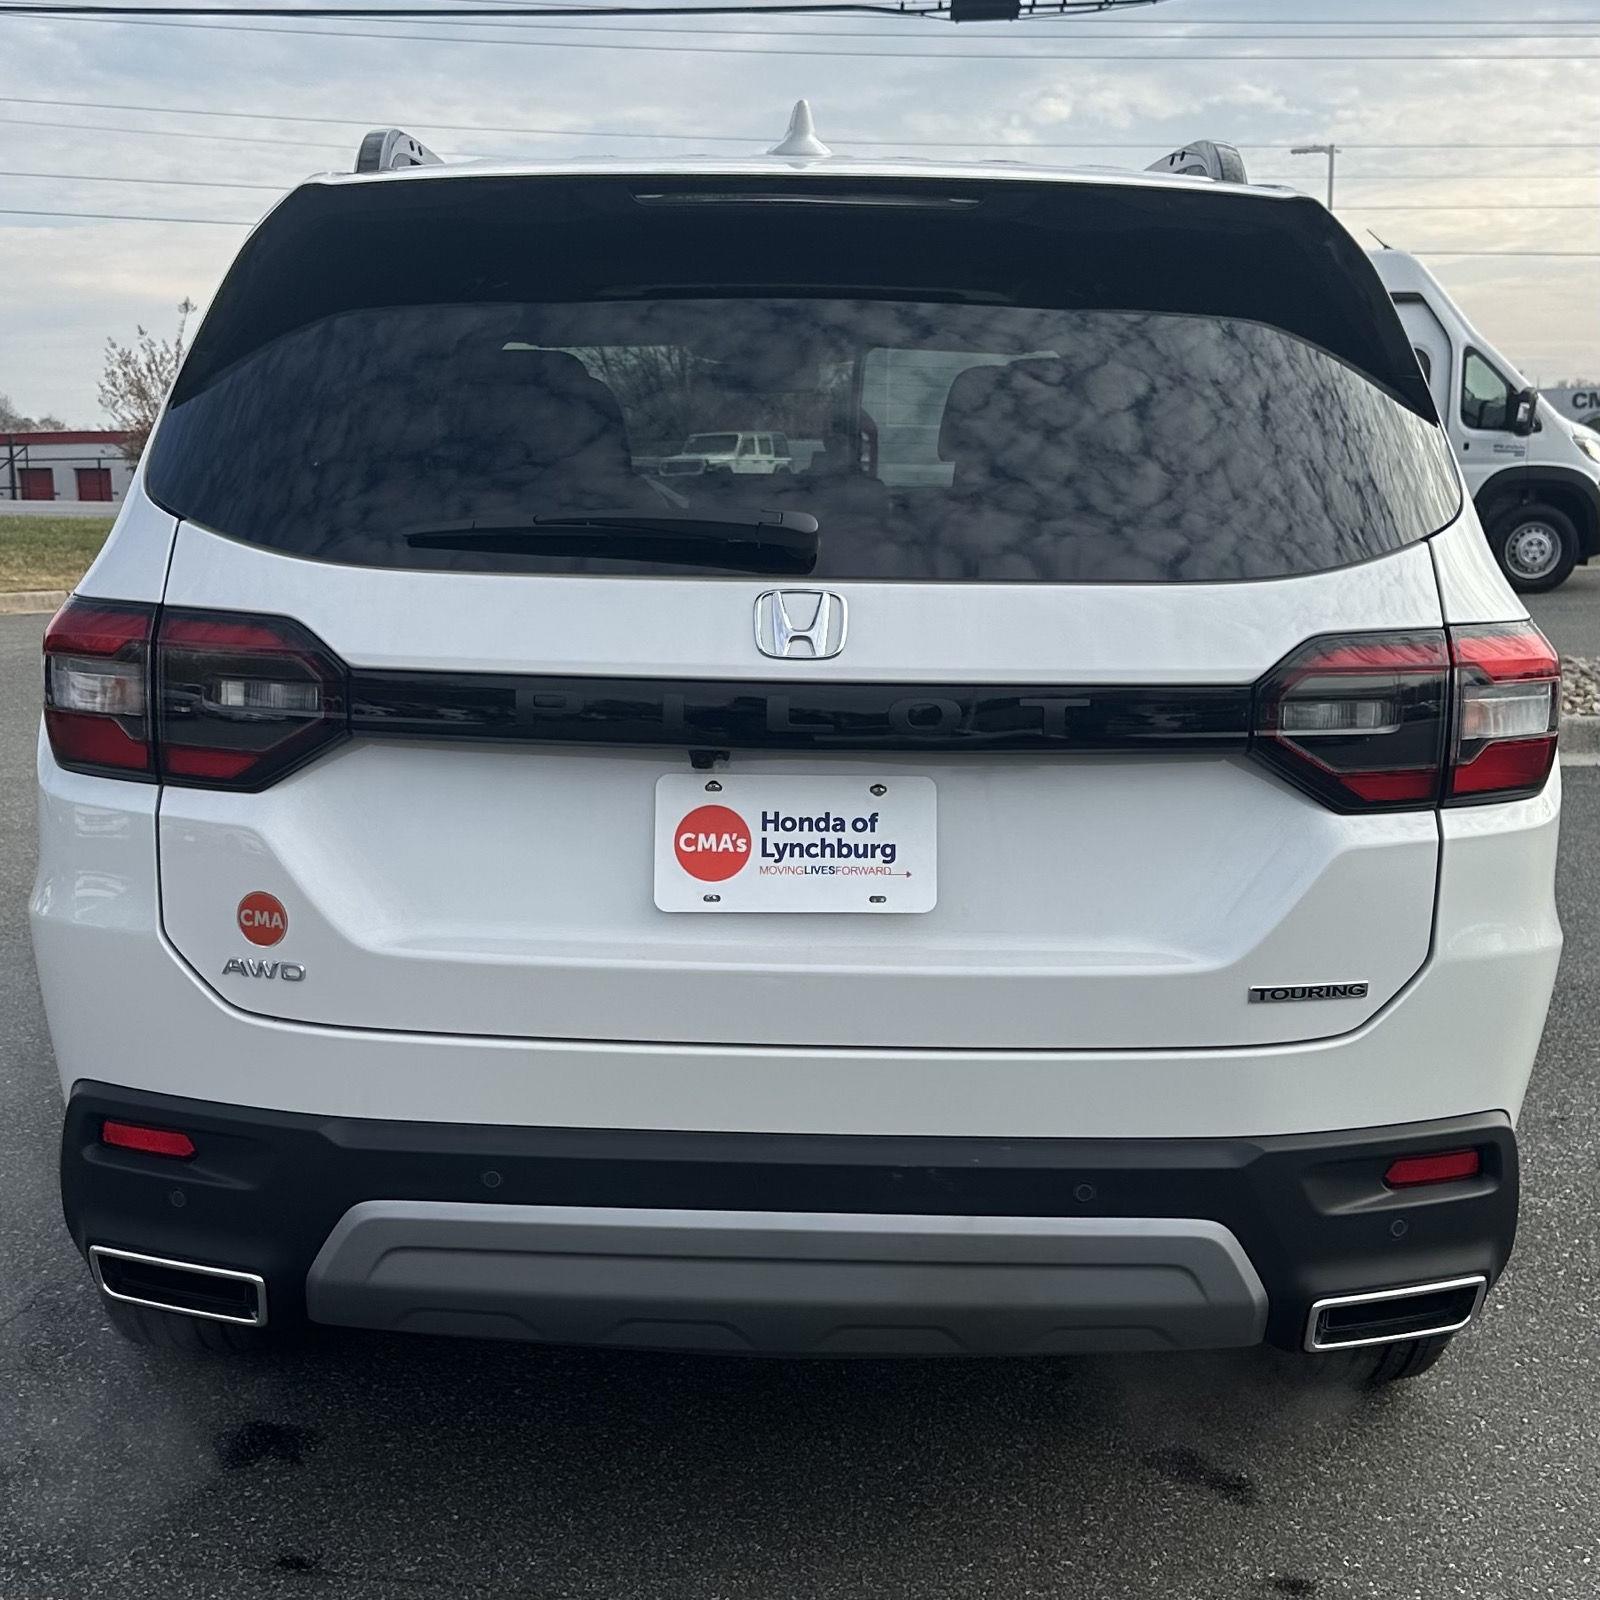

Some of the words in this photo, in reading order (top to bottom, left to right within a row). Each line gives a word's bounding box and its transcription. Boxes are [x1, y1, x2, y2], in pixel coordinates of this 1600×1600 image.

[515, 688, 1091, 738] PILOT
[761, 811, 846, 833] Honda
[851, 812, 879, 833] of
[678, 832, 748, 853] CMA's
[761, 837, 896, 864] Lynchburg
[240, 909, 284, 929] CMA
[222, 958, 306, 982] AWD
[1252, 983, 1366, 1001] TOURING
